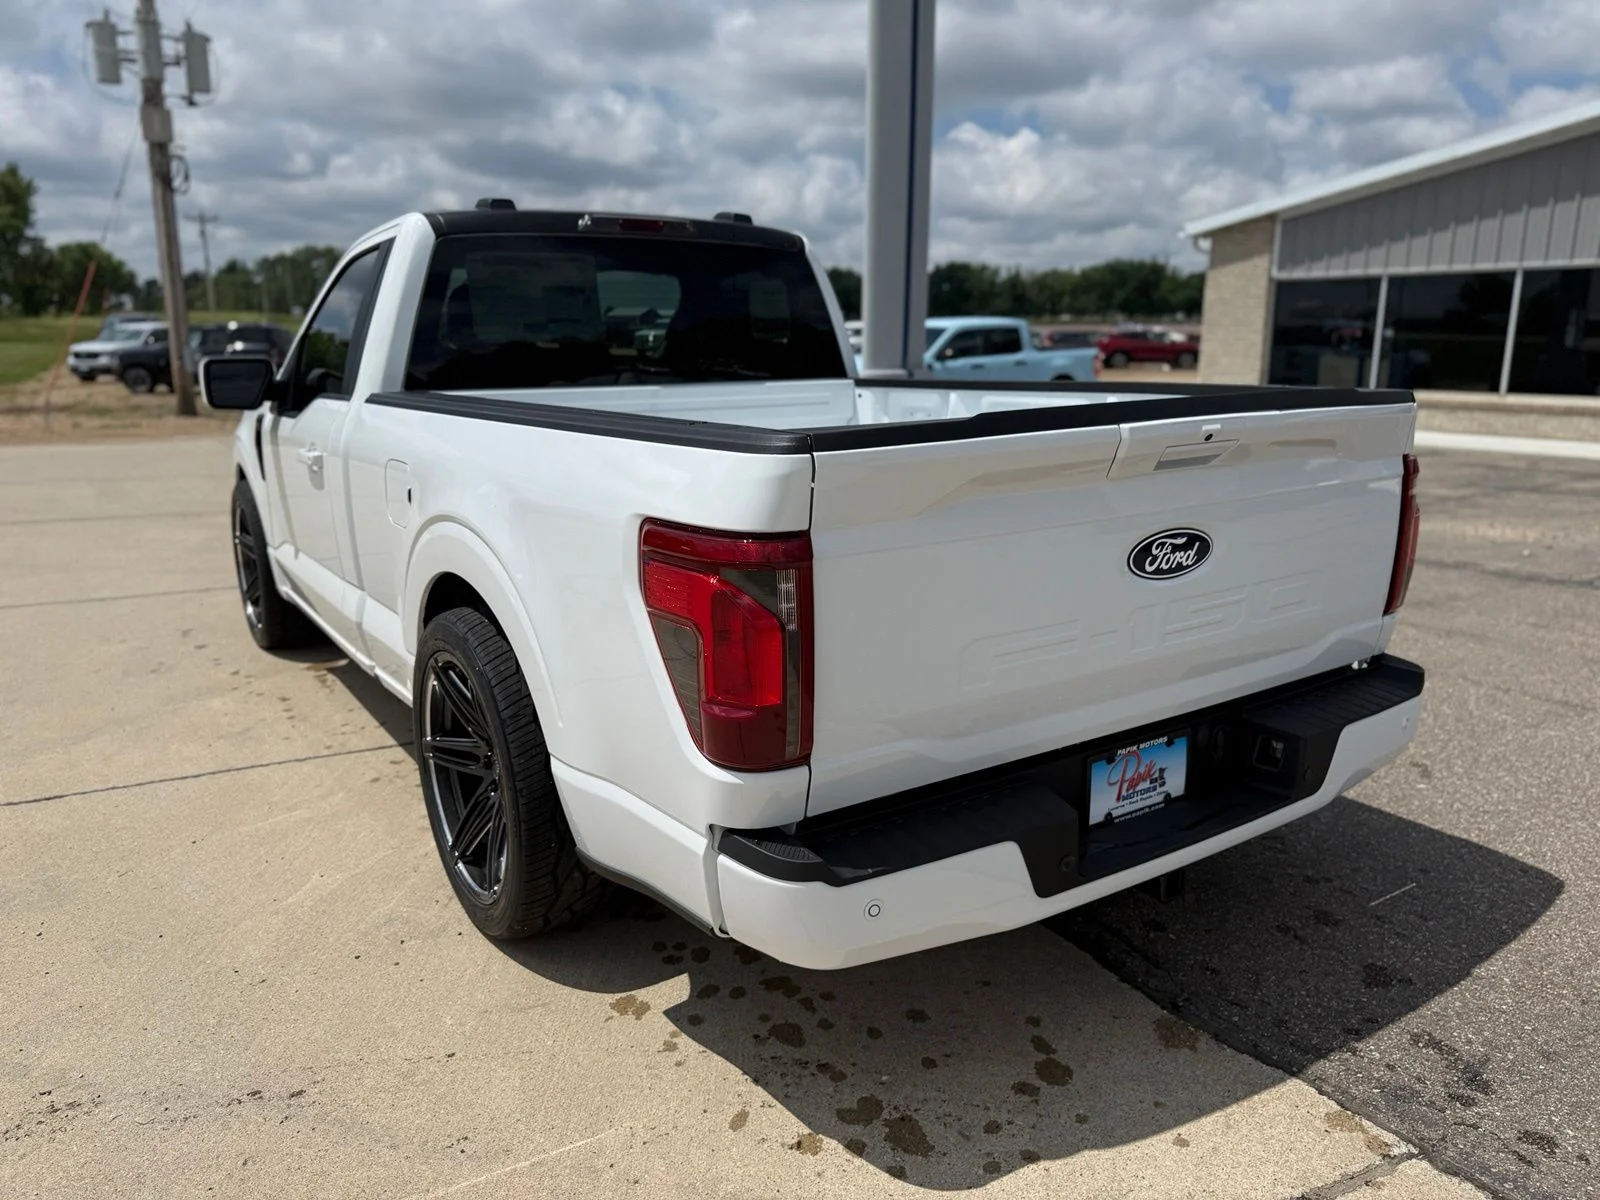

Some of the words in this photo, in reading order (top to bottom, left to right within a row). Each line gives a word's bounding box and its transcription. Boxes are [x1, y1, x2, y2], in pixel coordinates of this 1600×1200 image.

[1145, 536, 1199, 573] Ford
[959, 568, 1322, 691] F-150
[1117, 744, 1138, 756] PAPIK
[1139, 736, 1168, 749] MOTORS
[1107, 752, 1156, 802] Papik
[1121, 785, 1157, 801] MOTORS
